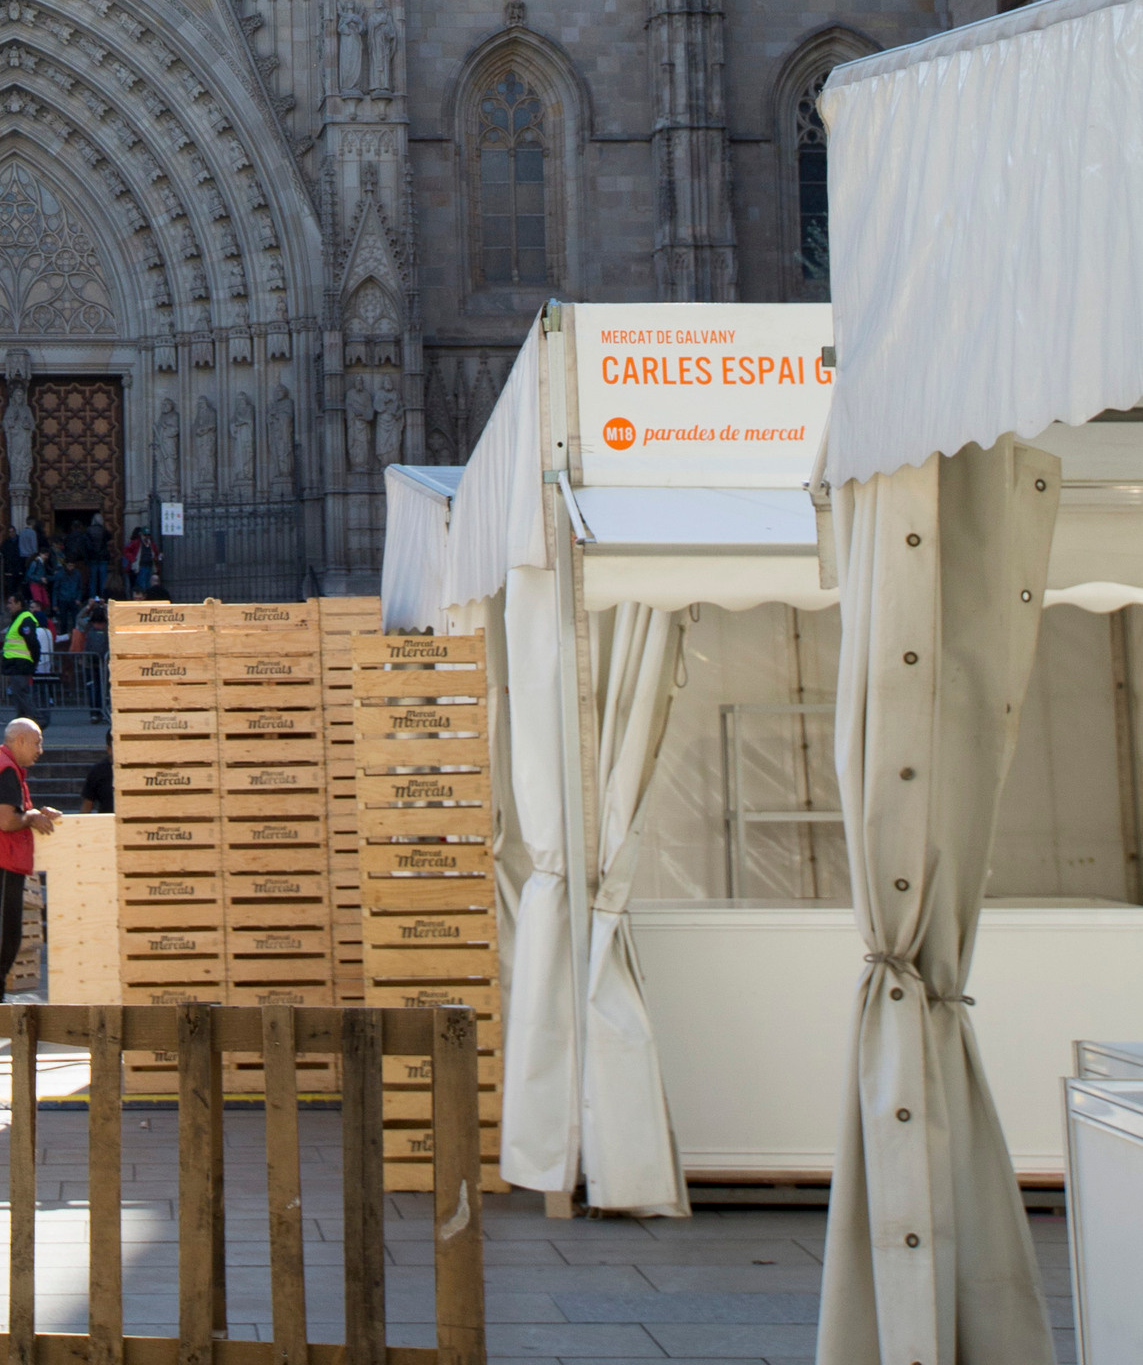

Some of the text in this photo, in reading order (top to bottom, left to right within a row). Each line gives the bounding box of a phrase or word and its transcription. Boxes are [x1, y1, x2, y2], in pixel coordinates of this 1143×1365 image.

[601, 330, 736, 344] MERCAT DE GALVANY
[602, 356, 712, 385] CARLES
[722, 357, 804, 385] ESPAI
[606, 425, 805, 446] M18 parades de mercat
[137, 612, 185, 623] Mercats
[242, 611, 290, 621] Mercats
[387, 644, 448, 657] Mercats
[139, 666, 187, 676] Mercats
[244, 664, 292, 675] Mercats
[140, 720, 189, 730] Mercats
[246, 719, 294, 729] Mercats
[389, 715, 450, 728] Mercats
[143, 775, 191, 786] Mercats
[248, 774, 297, 784] Mercats
[392, 785, 453, 797] Mercats
[144, 830, 192, 841] Mercats
[250, 829, 298, 839] Mercats
[412, 849, 441, 857] Mercat
[395, 854, 456, 867] Mercats
[147, 885, 194, 896] Mercats
[252, 882, 300, 893] Mercats
[399, 925, 460, 938] Mercats
[148, 940, 196, 950] Mercats
[253, 938, 301, 949] Mercats
